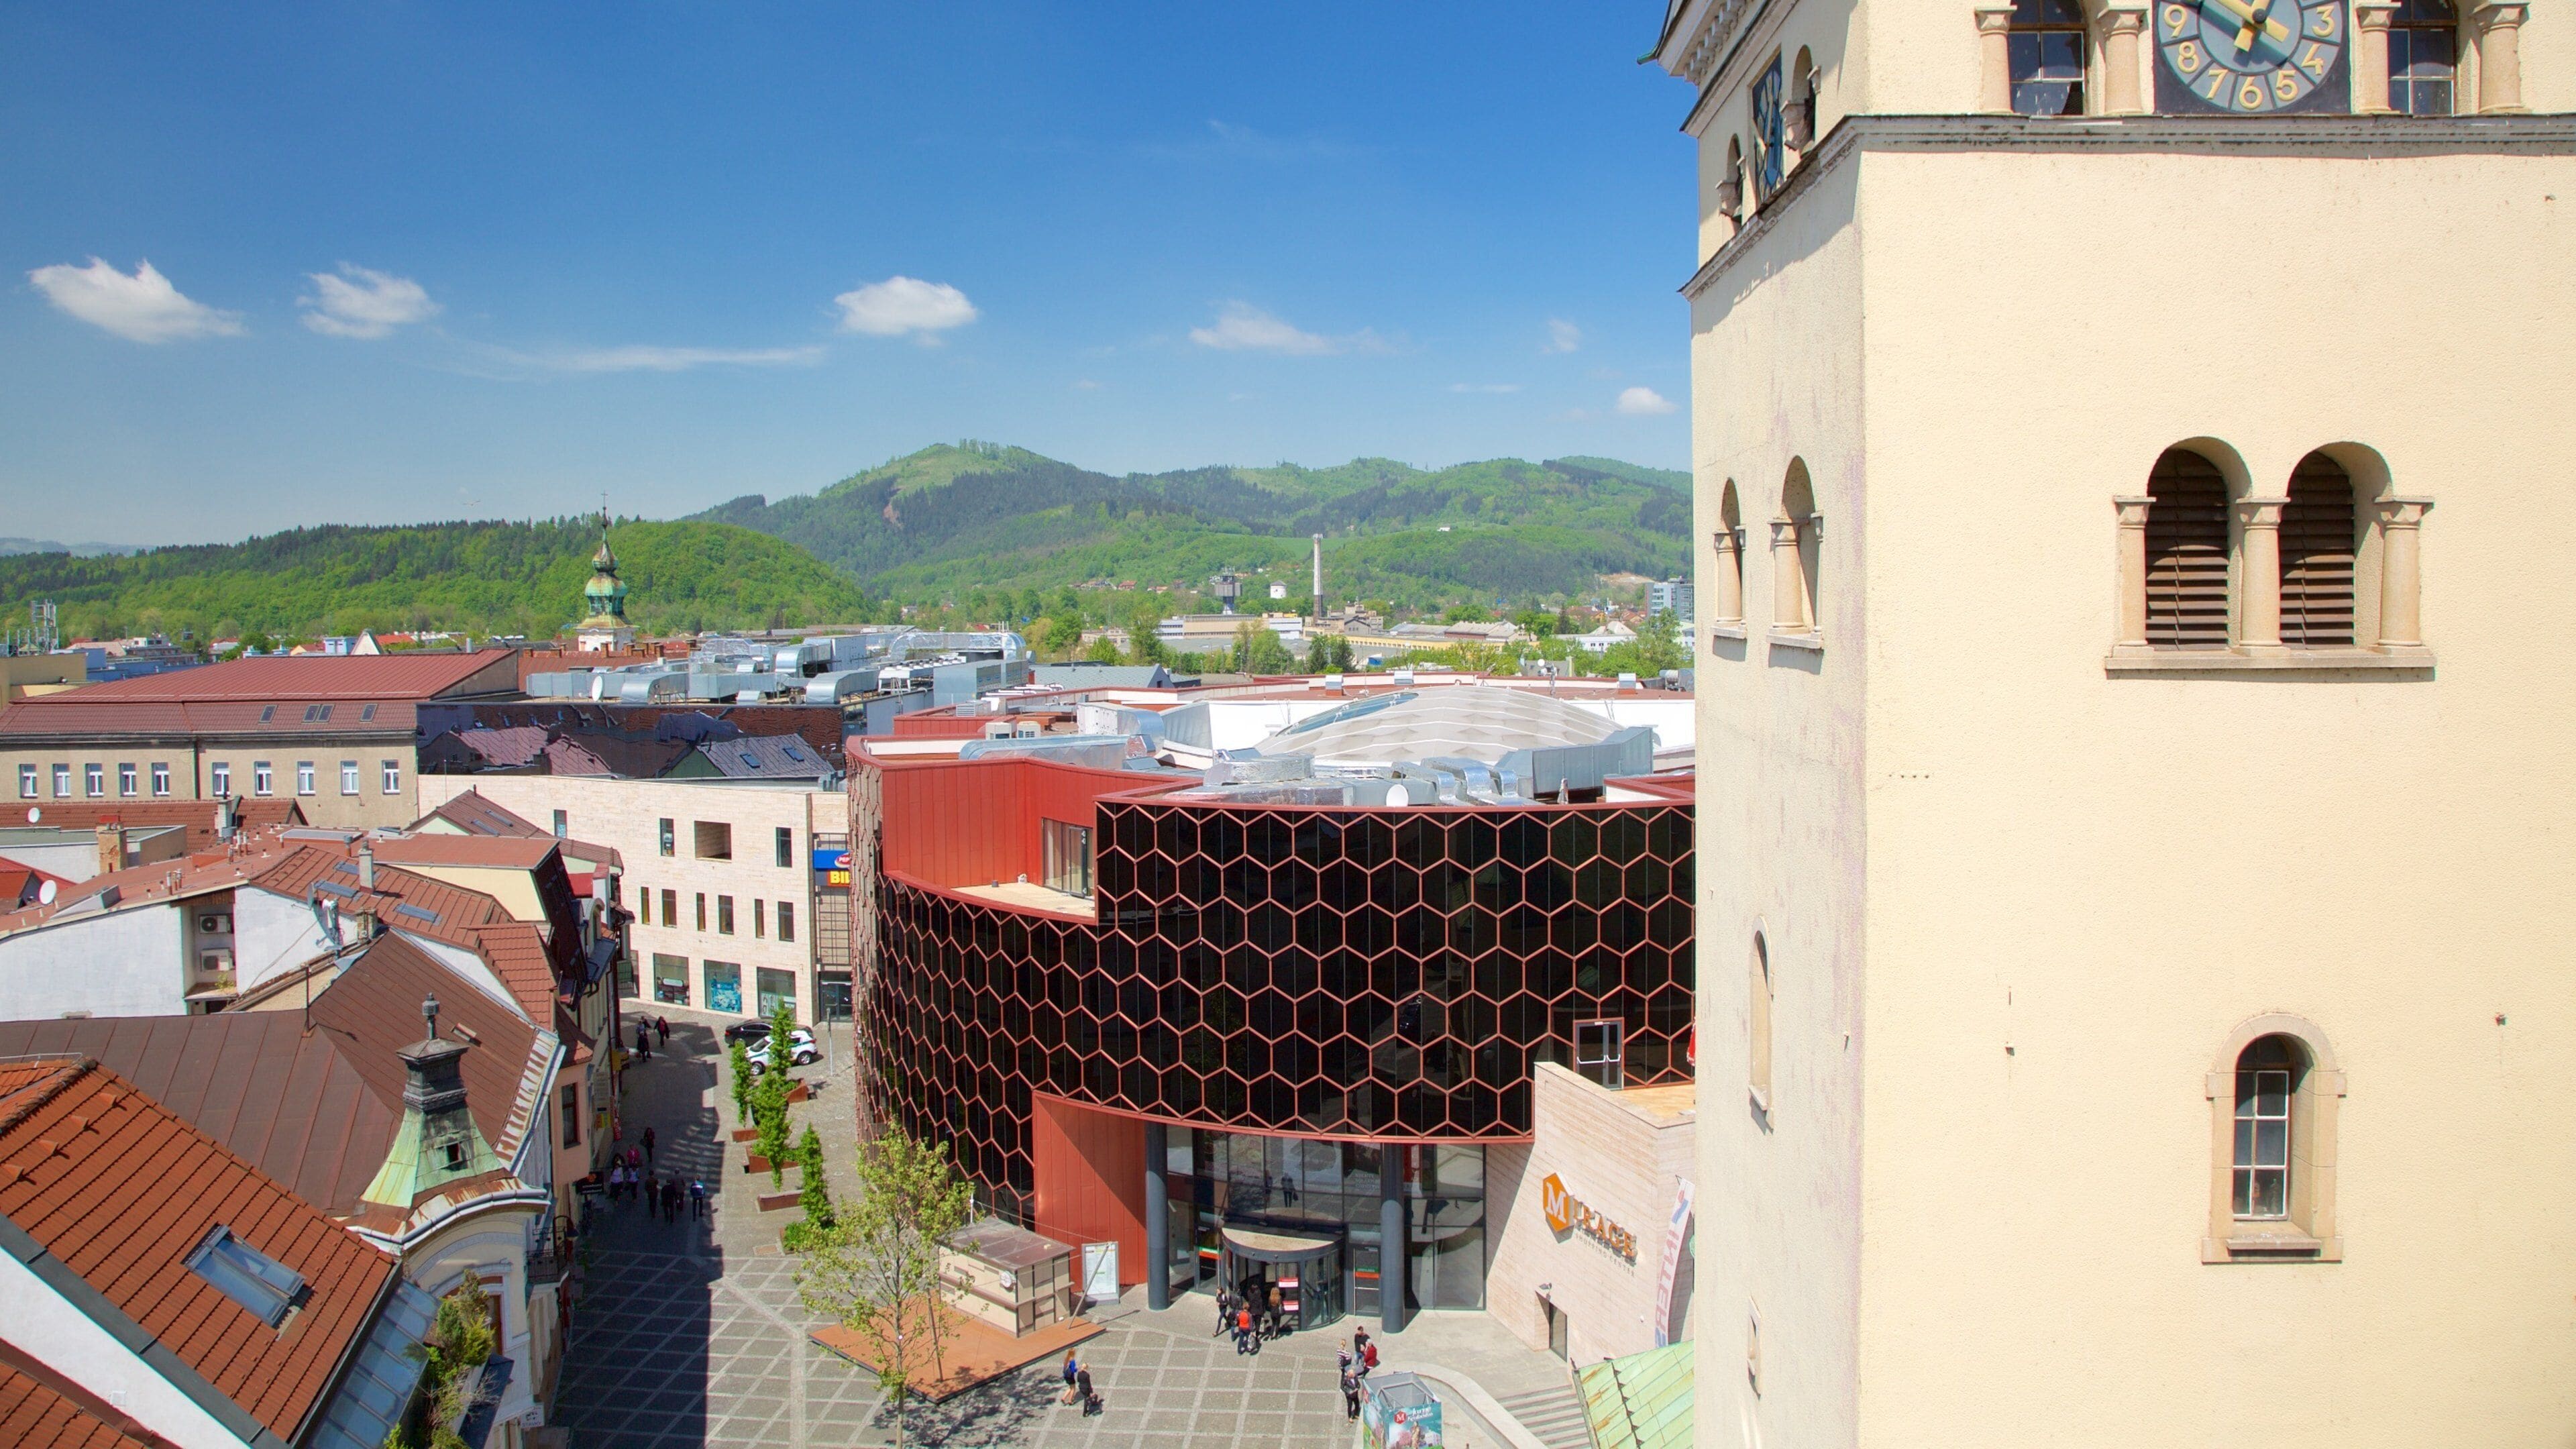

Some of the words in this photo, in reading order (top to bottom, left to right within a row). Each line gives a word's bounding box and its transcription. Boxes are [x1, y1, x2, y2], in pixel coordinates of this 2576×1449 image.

[2163, 4, 2188, 38] 9
[2312, 5, 2336, 38] 3
[2177, 41, 2200, 74] 8
[2300, 44, 2324, 75] 4
[2206, 69, 2231, 99] 7
[2239, 76, 2263, 109] 6
[2275, 70, 2298, 101] 5
